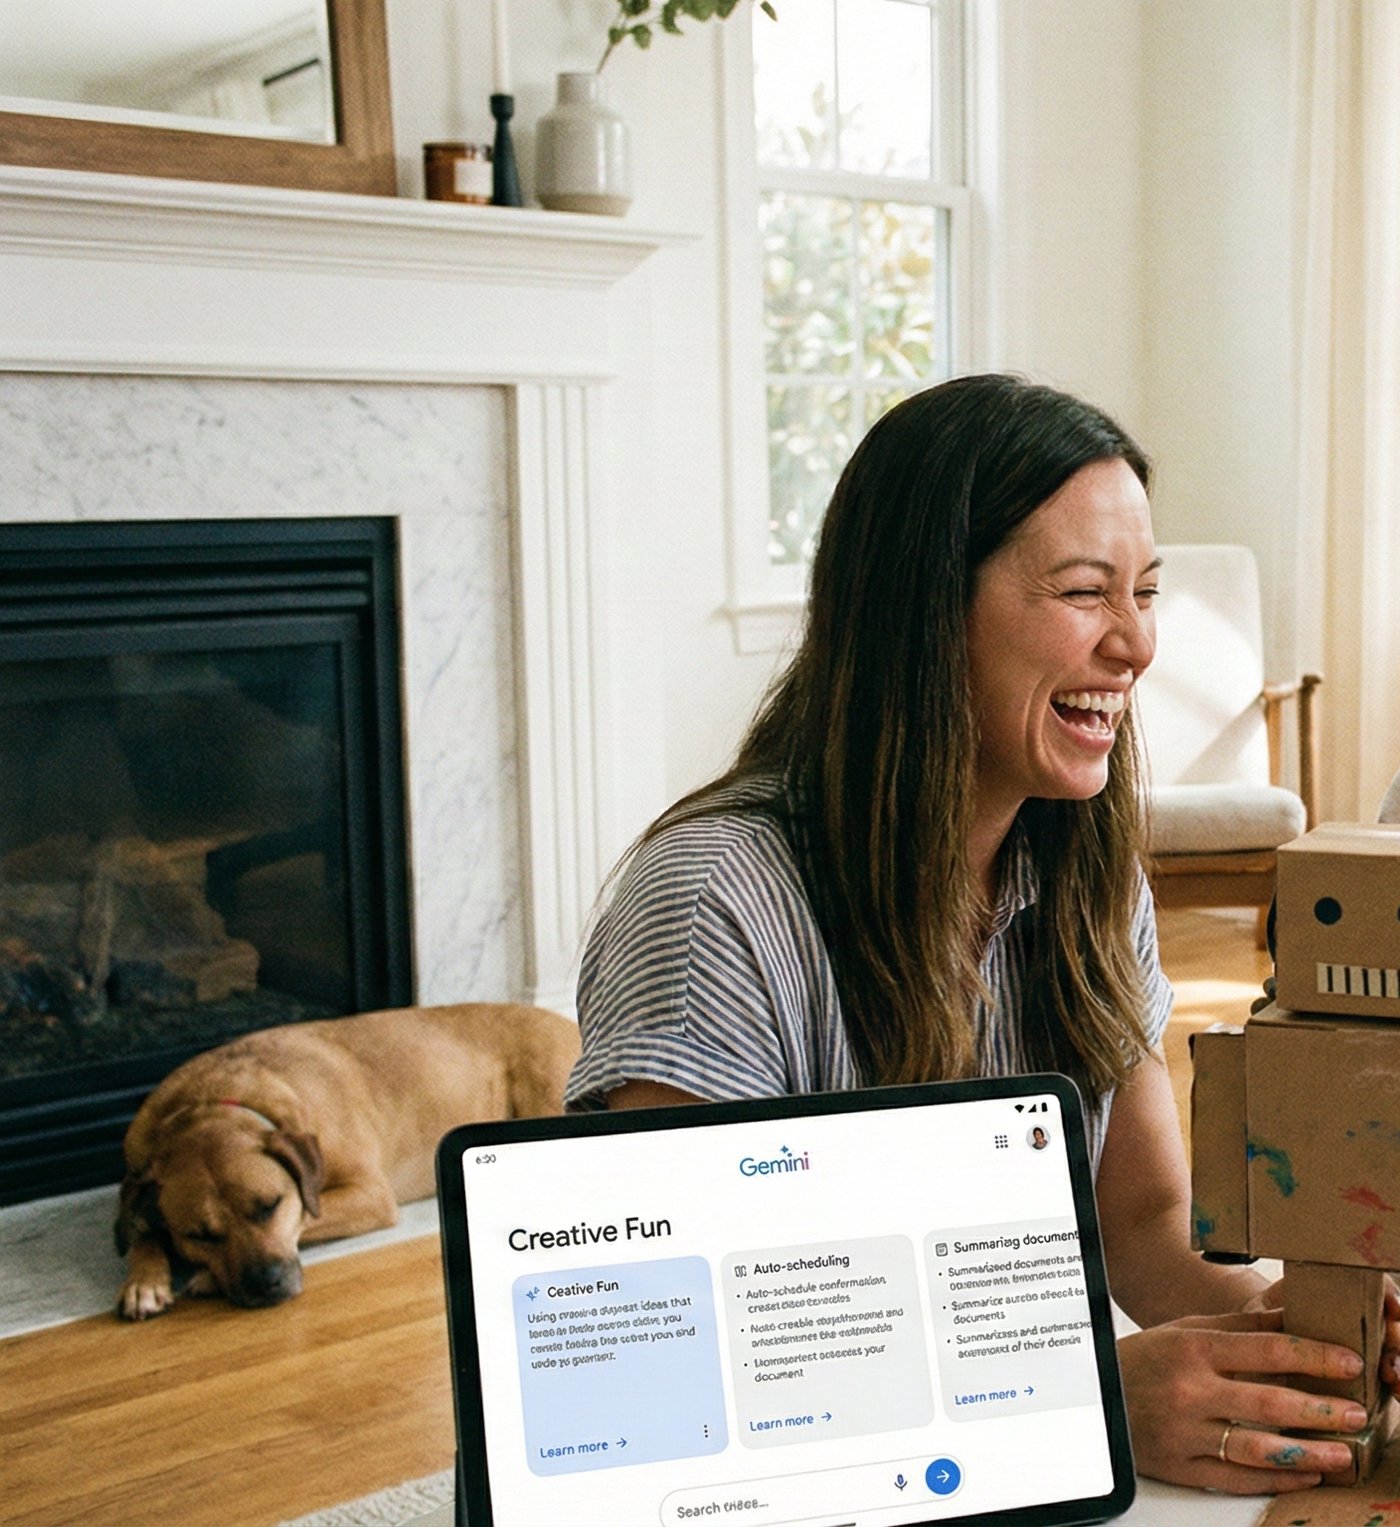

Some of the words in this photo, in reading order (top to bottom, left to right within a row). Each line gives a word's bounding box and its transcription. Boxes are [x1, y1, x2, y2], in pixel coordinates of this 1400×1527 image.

[739, 1151, 810, 1177] Gemini
[508, 1221, 618, 1251] Creative
[625, 1217, 672, 1240] Fun
[753, 1255, 850, 1275] Auto-scheduling
[547, 1283, 594, 1299] Ceative
[596, 1280, 620, 1293] Fun
[527, 1311, 557, 1324] Using
[670, 1297, 692, 1308] that
[663, 1314, 682, 1326] you
[954, 1391, 987, 1406] Learn
[749, 1417, 783, 1433] Learn
[785, 1413, 815, 1428] more
[539, 1445, 575, 1459] Learn
[578, 1441, 609, 1454] more
[677, 1501, 721, 1519] Search
